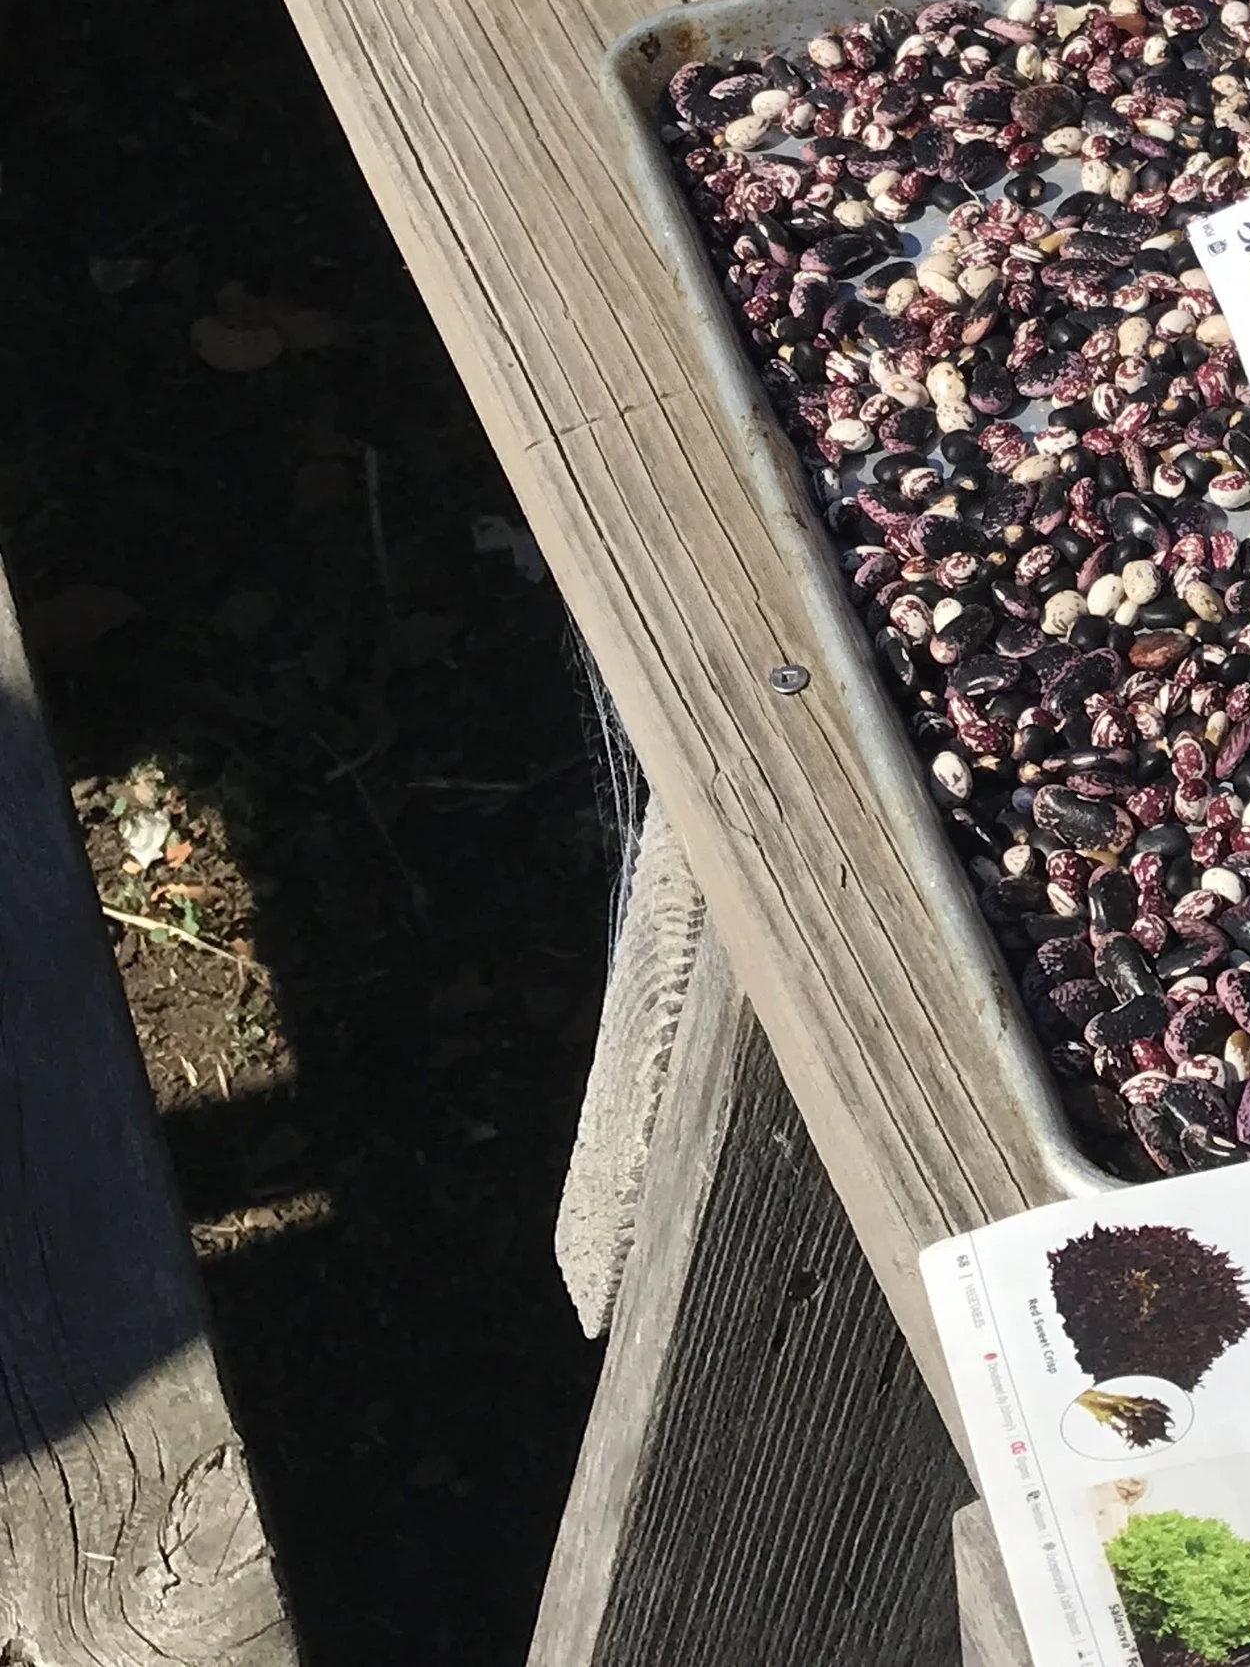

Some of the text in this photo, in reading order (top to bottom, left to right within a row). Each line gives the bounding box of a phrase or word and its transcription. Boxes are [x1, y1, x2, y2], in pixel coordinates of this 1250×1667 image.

[1027, 1297, 1057, 1374] Red Sweet Crisp
